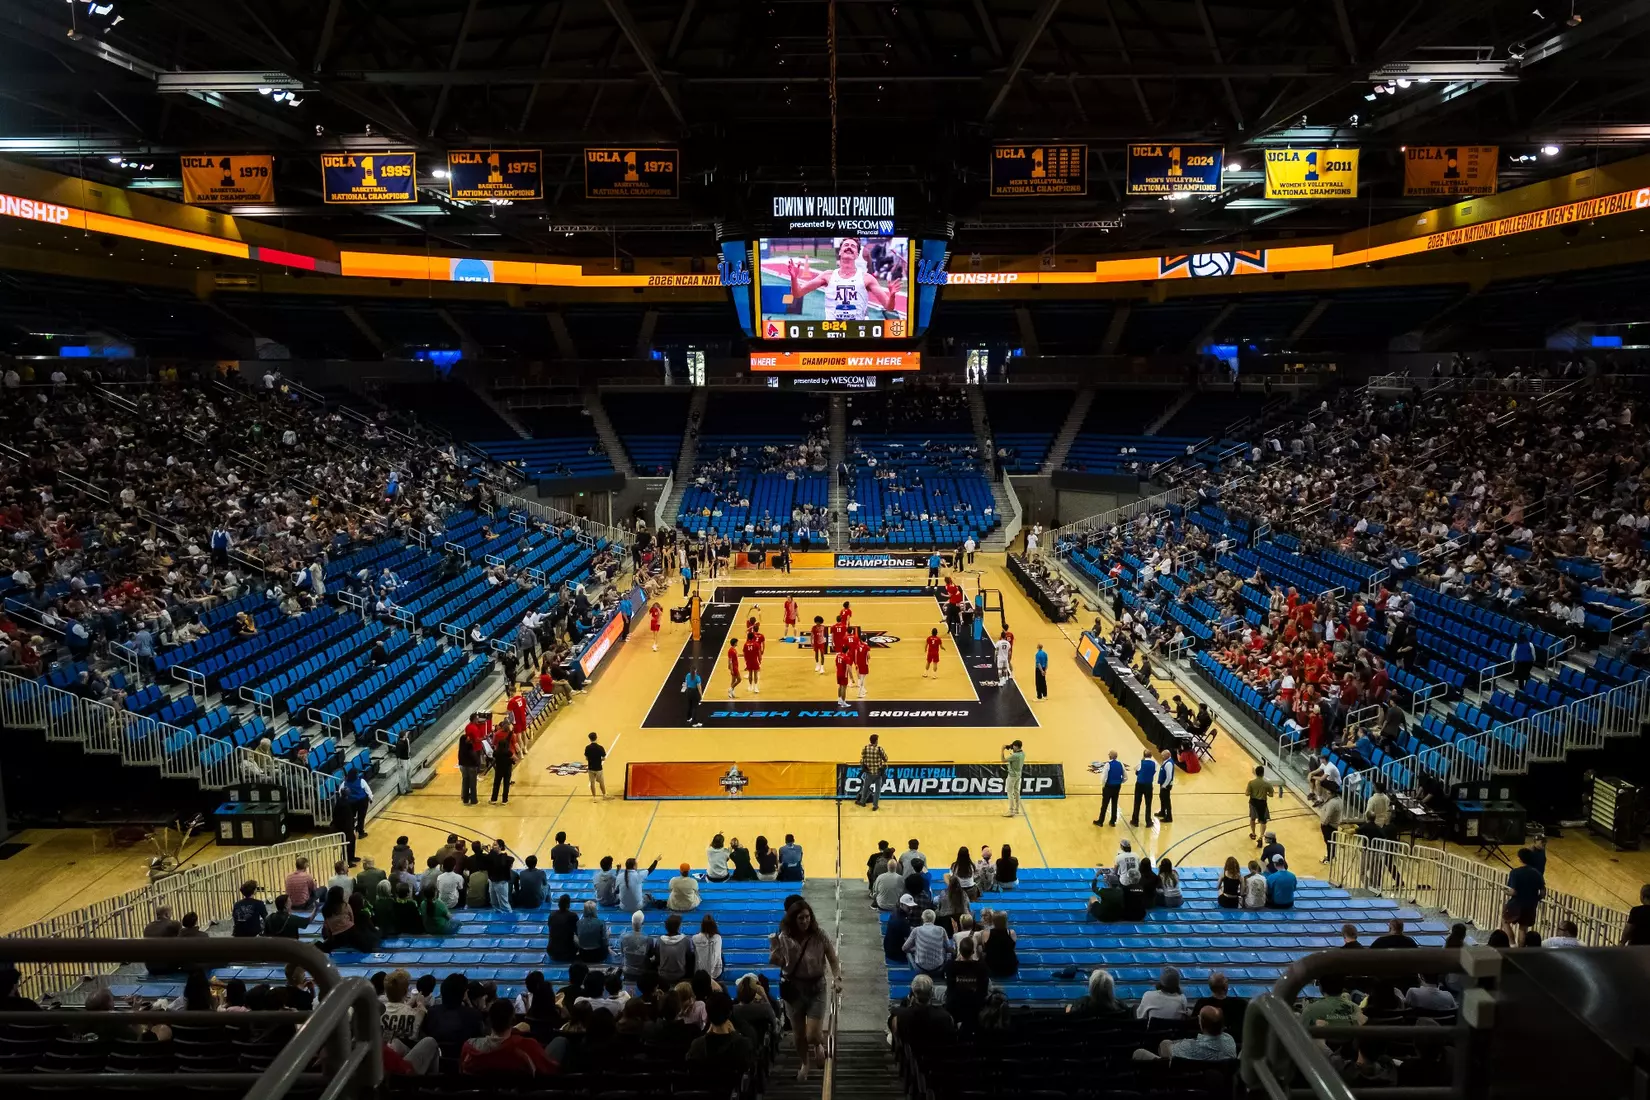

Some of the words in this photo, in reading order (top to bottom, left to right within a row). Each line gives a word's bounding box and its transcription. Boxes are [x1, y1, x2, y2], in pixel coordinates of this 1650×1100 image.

[996, 149, 1026, 158] UCLA
[1133, 147, 1163, 156] UCLA
[1268, 152, 1300, 161] UCLA
[1408, 149, 1443, 160] UCLA
[324, 157, 356, 167] UCLA
[451, 153, 482, 163] UCLA
[588, 152, 621, 162] UCLA
[1168, 147, 1182, 176] 1
[1187, 156, 1214, 166] 2024
[183, 158, 214, 168] UCLA
[488, 153, 503, 182] 1
[508, 162, 536, 173] 1975
[624, 152, 639, 181] 1
[644, 161, 673, 172] 1973
[1032, 148, 1046, 177] 1
[1305, 152, 1319, 180] 1
[1326, 161, 1352, 171] 2011
[1444, 148, 1460, 178] 1
[219, 157, 235, 187] 1
[240, 167, 267, 177] 1978
[361, 156, 377, 186] 1
[381, 165, 411, 177] 1995
[1037, 185, 1081, 193] CHAMPIONS
[368, 192, 409, 200] CHAMPIONS
[773, 196, 803, 216] EDWIN
[805, 196, 815, 216] W
[817, 196, 851, 216] PAULEY
[853, 196, 894, 216] PAVILION
[790, 220, 824, 230] presented
[826, 220, 835, 230] by
[837, 220, 879, 230] WESCOM
[1427, 234, 1444, 249] 2026
[1445, 230, 1462, 245] NCAA
[1463, 224, 1497, 243] NATIONAL
[1499, 212, 1544, 234] COLLEGIATE
[1545, 205, 1574, 226] MEN'S
[1576, 192, 1633, 220] VOLLEYBALL
[648, 276, 673, 286] 2026
[675, 276, 699, 286] NCAA
[822, 321, 847, 331] 8:24
[790, 326, 799, 338] 0
[873, 326, 882, 338] 0
[757, 358, 776, 366] HERE
[802, 358, 846, 366] CHAMPIONS
[848, 357, 873, 366] WIN
[876, 357, 902, 365] HERE
[822, 377, 829, 385] by
[711, 710, 791, 718] HERE
[896, 767, 957, 779] VOLLEYBALL
[844, 777, 1053, 793] CAMPIONSIP
